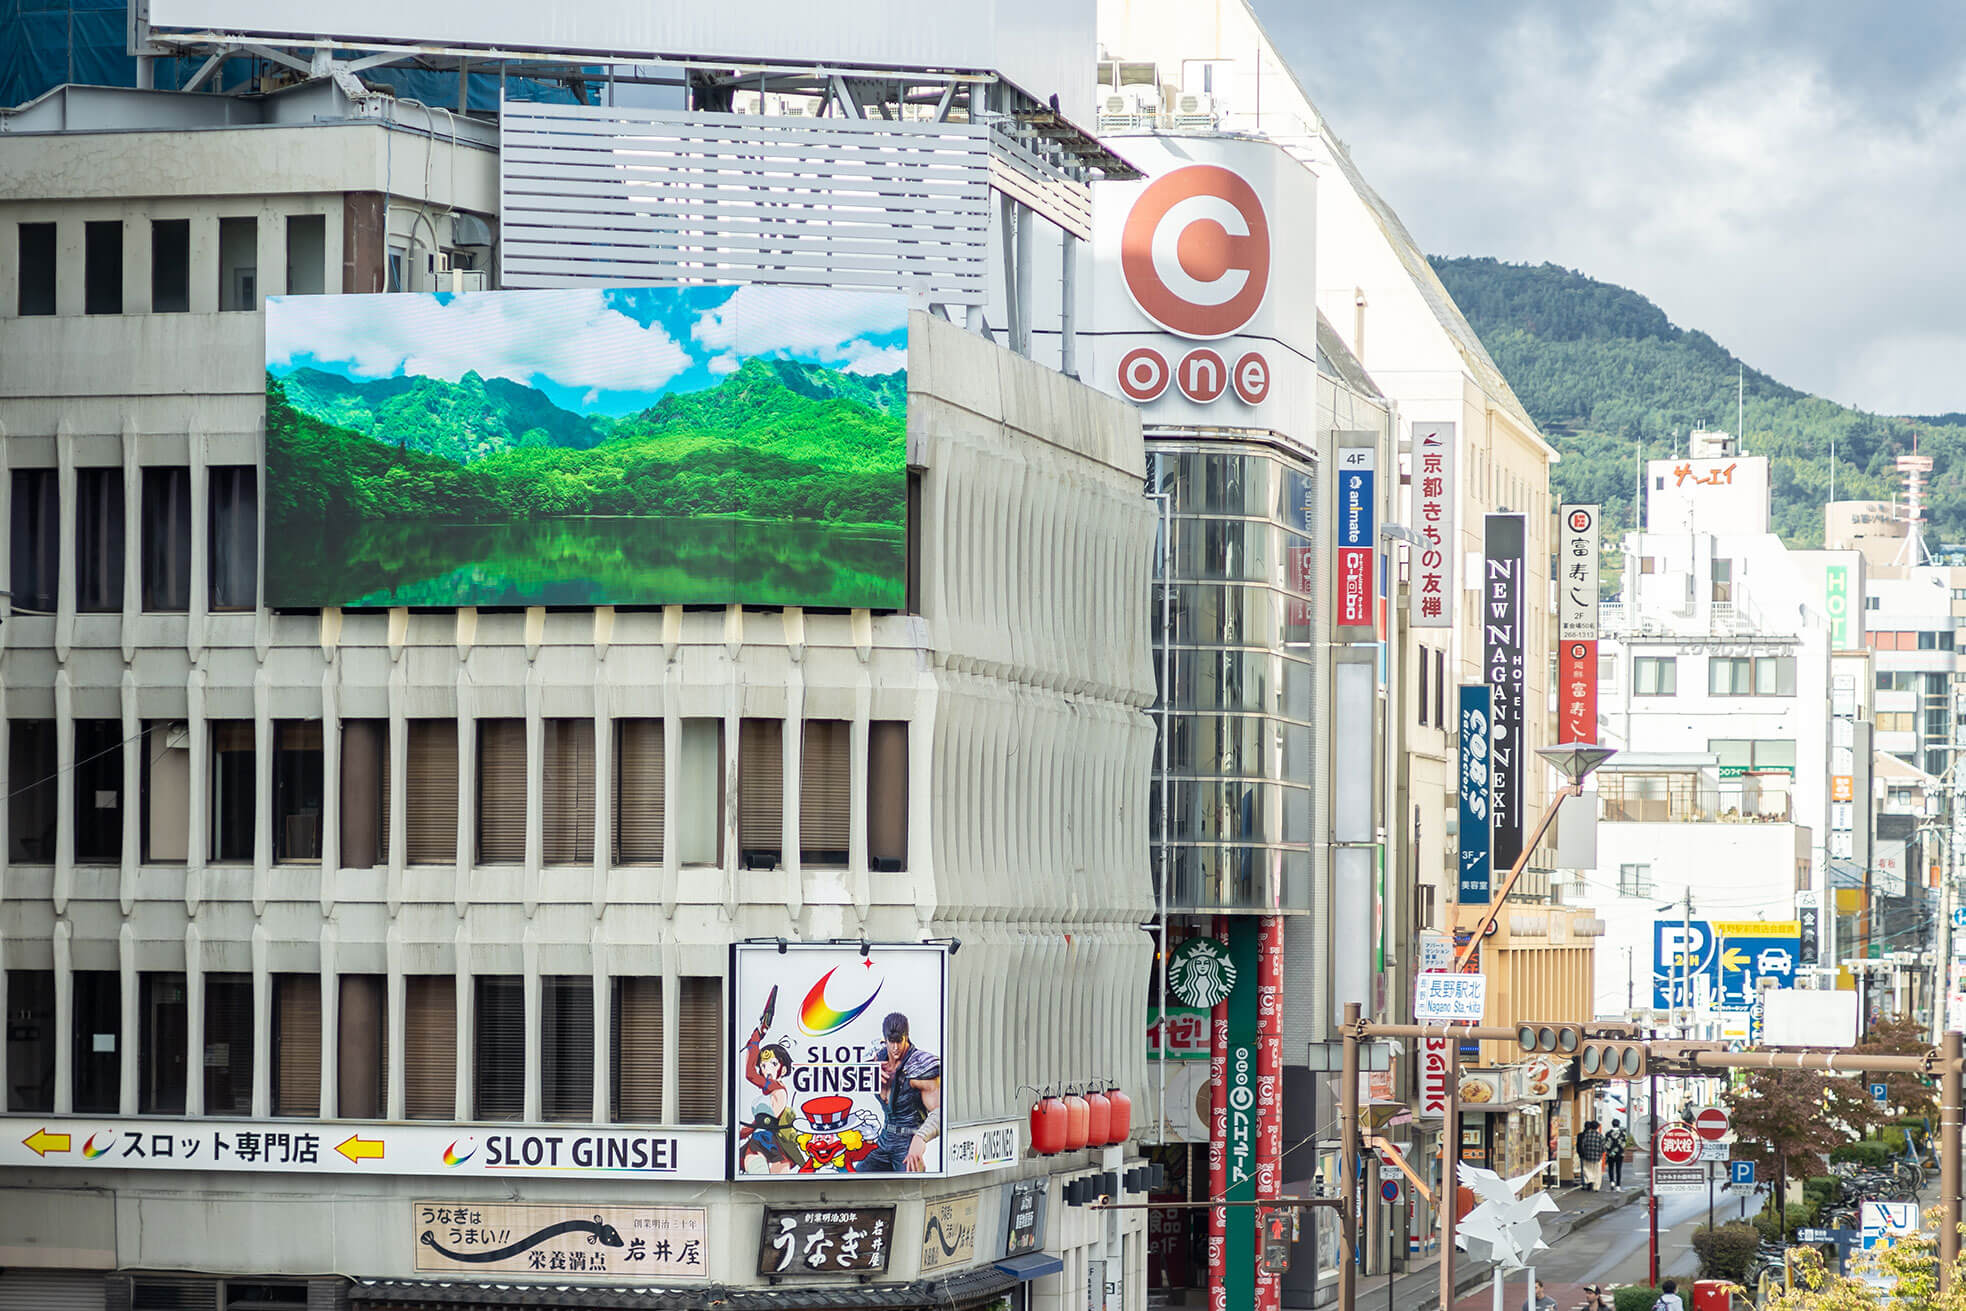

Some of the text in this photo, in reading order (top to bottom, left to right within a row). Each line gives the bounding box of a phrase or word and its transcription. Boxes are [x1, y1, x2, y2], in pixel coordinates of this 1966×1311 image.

[1126, 357, 1265, 396] one
[1347, 454, 1365, 464] 4F
[1349, 491, 1363, 543] animate
[1422, 453, 1443, 618] 京都きちの友禅
[1513, 655, 1522, 719] HOTEL
[1462, 851, 1474, 859] 3F
[1461, 881, 1488, 890] 美容室
[1430, 980, 1480, 999] 長野駅北
[1427, 1000, 1451, 1014] Nagano
[807, 1046, 866, 1063] SLOT
[793, 1066, 881, 1093] GINSEI
[1874, 1086, 1883, 1097] P
[122, 1131, 320, 1164] スロット専門店
[486, 1136, 678, 1169] SLOT GINSEI
[1233, 1112, 1249, 1182] アールエフ
[1663, 1138, 1693, 1153] 消火栓
[1738, 1164, 1750, 1181] P
[422, 1208, 482, 1225] うなぎは
[634, 1219, 697, 1231] 創業明治三十年
[805, 1213, 858, 1224] 創業明治30年
[624, 1238, 701, 1266] 岩井屋
[773, 1217, 868, 1272] うなぎ
[868, 1219, 885, 1267] 岩井屋
[528, 1251, 608, 1271] 栄養満点
